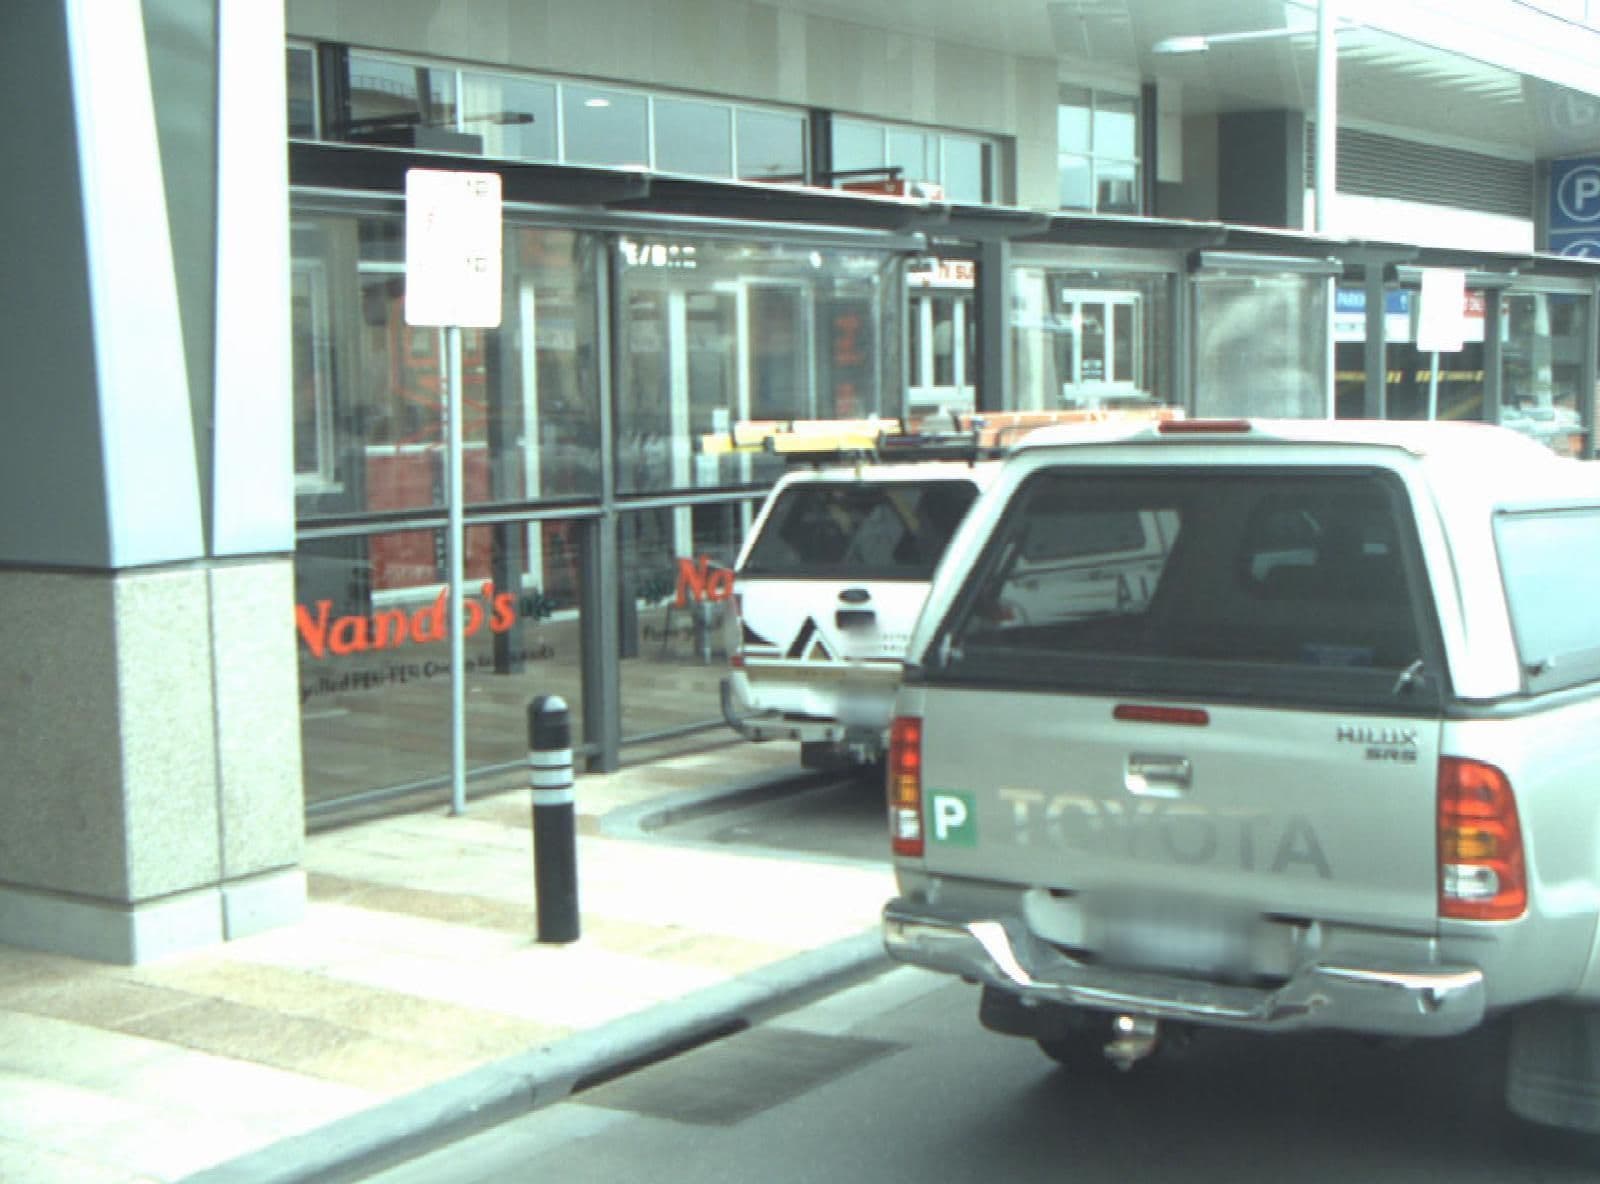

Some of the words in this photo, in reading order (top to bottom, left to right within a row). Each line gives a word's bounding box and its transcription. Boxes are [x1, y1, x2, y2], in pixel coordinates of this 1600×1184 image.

[1573, 176, 1600, 211] P
[295, 580, 517, 661] Nando's
[1335, 726, 1417, 746] HILUX
[932, 795, 969, 842] P
[998, 787, 1333, 881] TOYOTA
